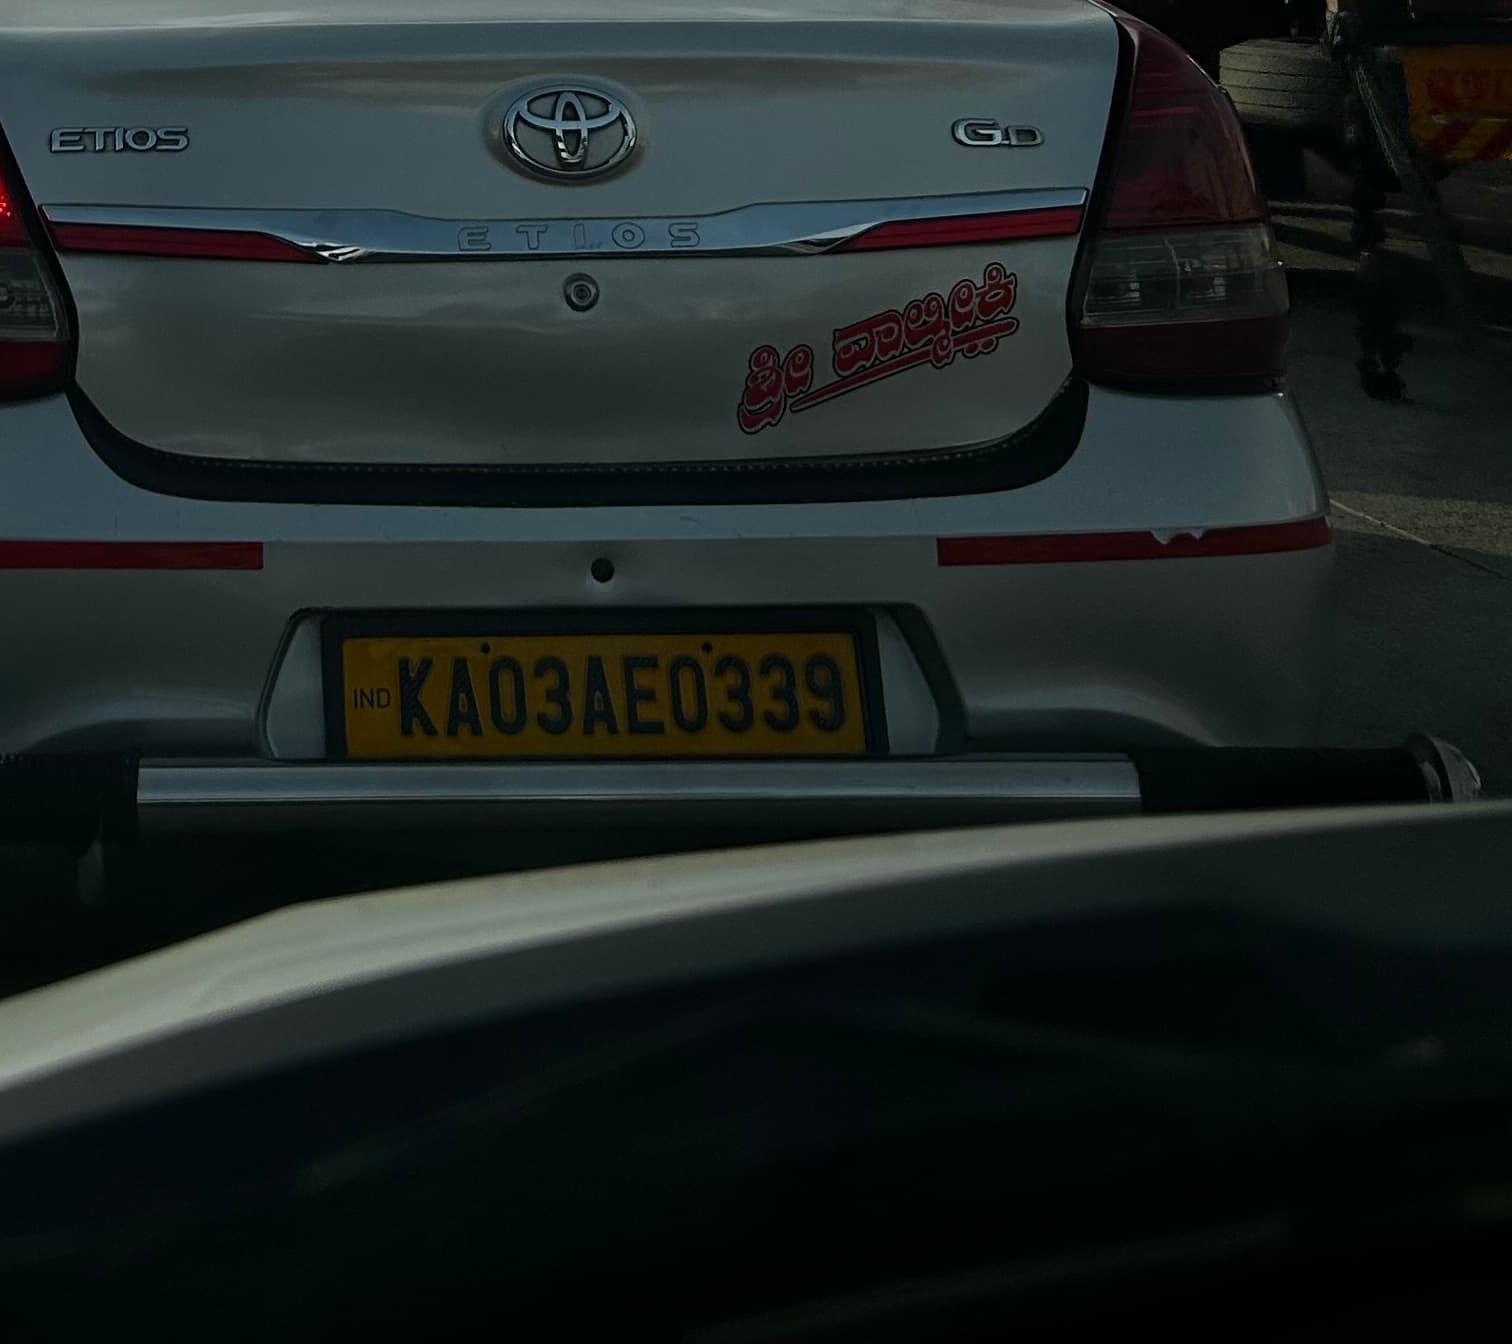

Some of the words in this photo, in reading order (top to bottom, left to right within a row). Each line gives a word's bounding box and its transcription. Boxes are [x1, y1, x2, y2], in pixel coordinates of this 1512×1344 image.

[50, 127, 190, 153] ETIOS
[457, 221, 701, 252] ETIOS
[738, 345, 814, 434] ಶ್ರೀ
[353, 686, 392, 709] IND
[397, 653, 847, 737] KA03AE0339
